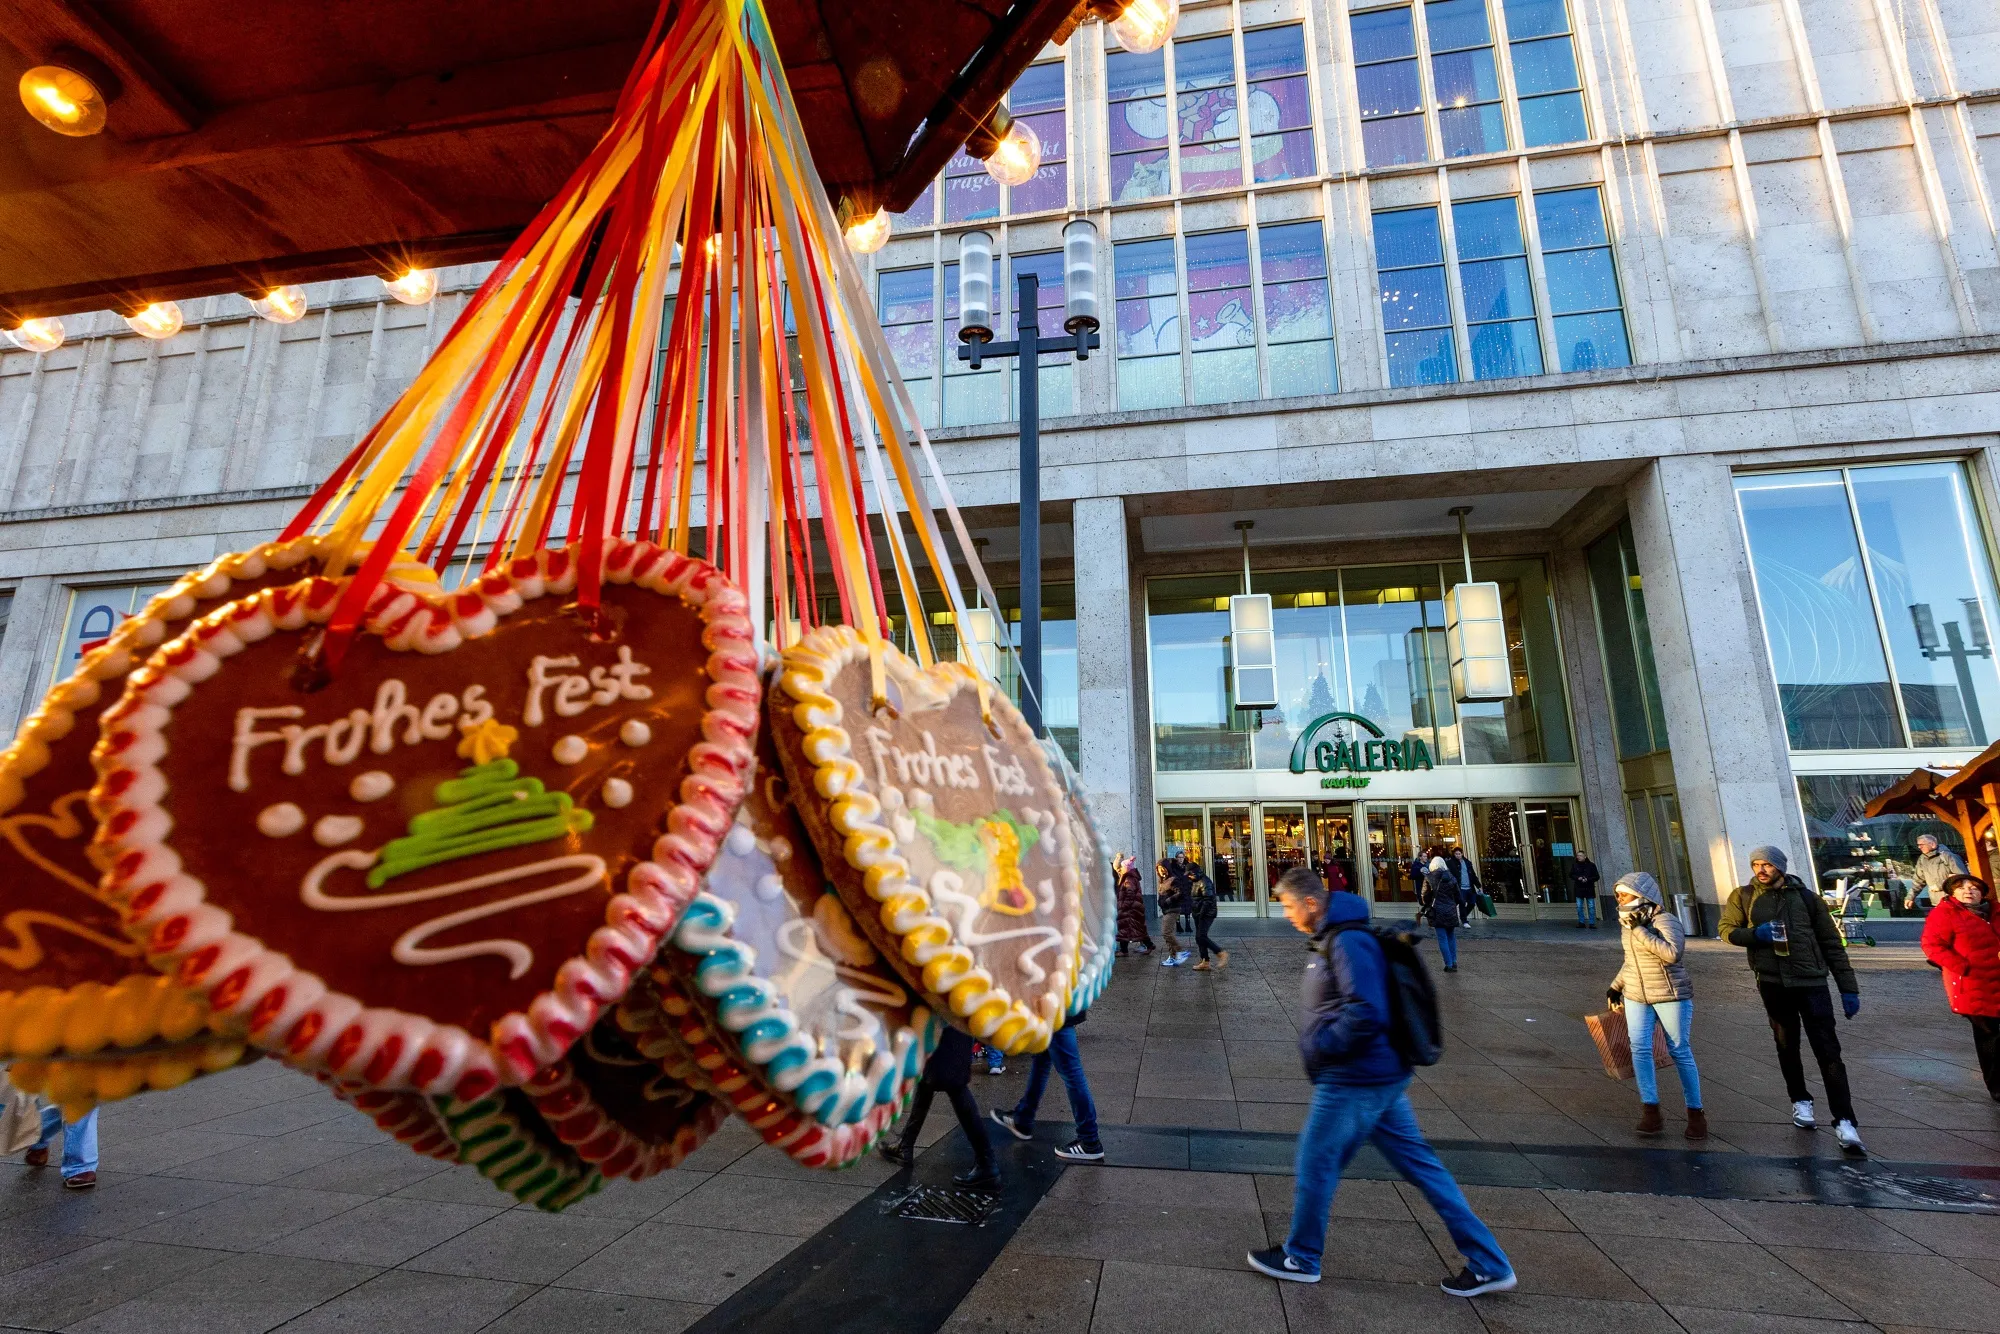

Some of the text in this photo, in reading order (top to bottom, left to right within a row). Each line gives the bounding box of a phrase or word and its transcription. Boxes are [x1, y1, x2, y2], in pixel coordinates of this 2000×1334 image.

[229, 645, 653, 791] Frohes Fest
[865, 726, 979, 789] Frohes
[1315, 739, 1434, 772] GALERIA
